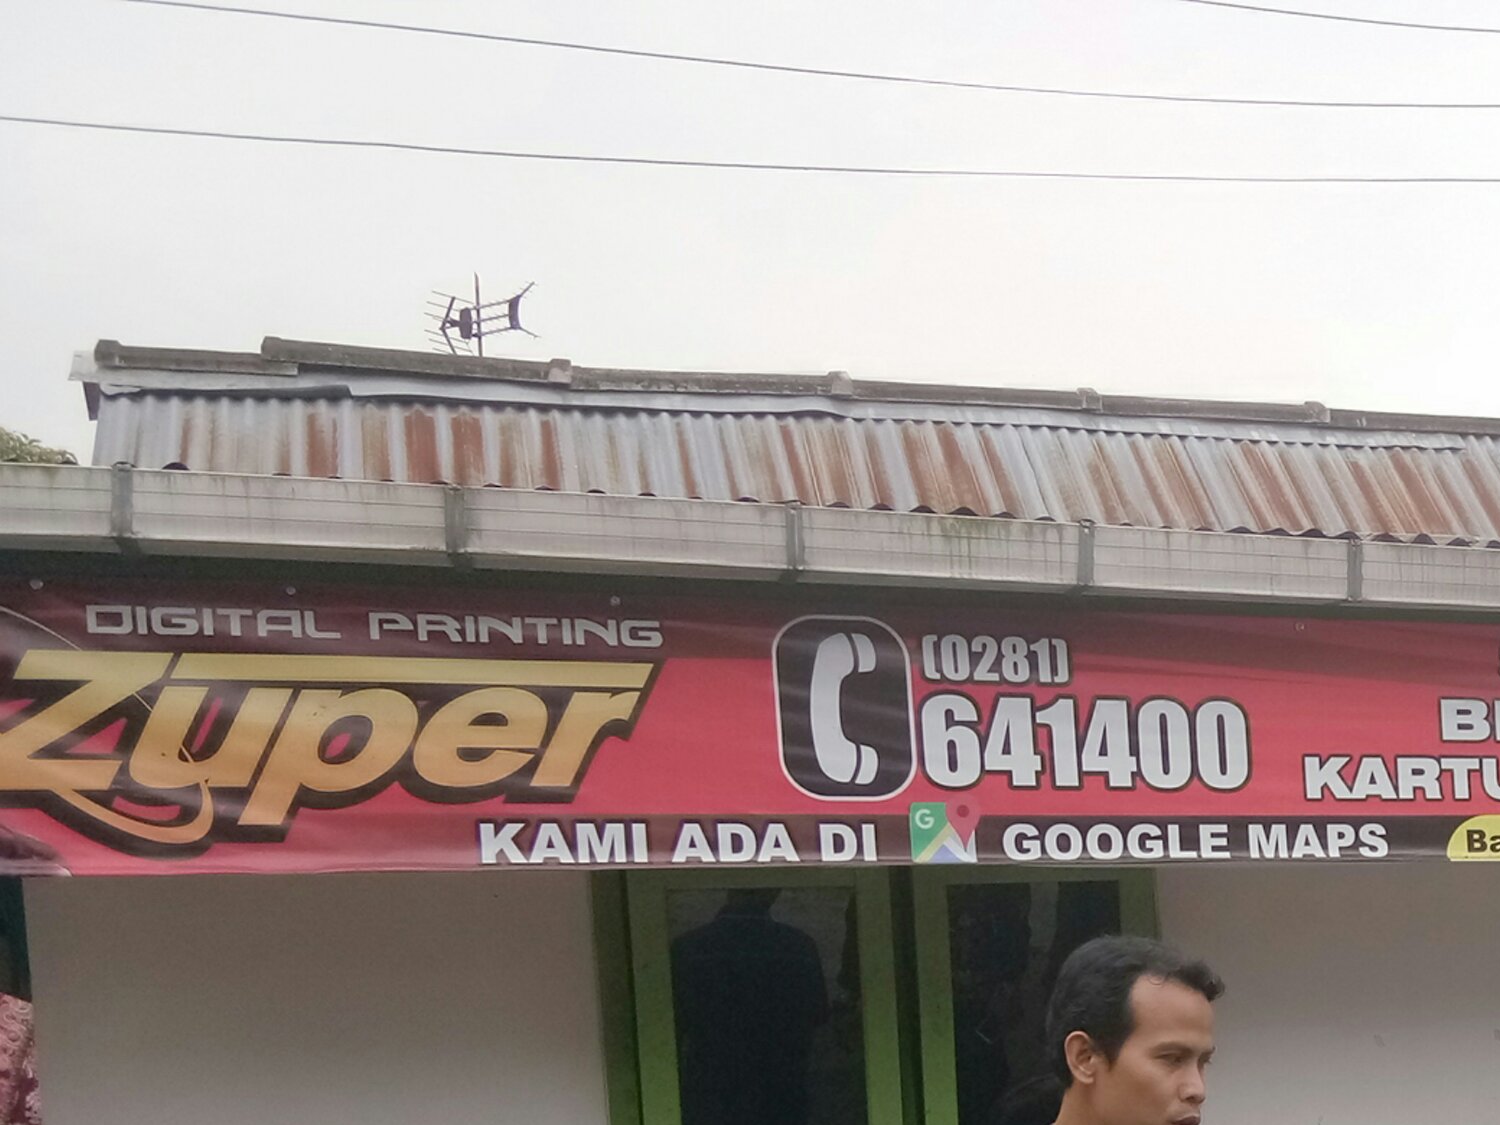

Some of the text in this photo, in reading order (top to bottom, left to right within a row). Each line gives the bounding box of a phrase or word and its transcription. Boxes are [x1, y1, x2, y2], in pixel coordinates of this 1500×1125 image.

[86, 604, 664, 648] DIGITAL PRINTING
[921, 634, 1070, 684] (0281)
[920, 694, 1251, 789] 641400
[479, 822, 878, 864] KAMI ADA DI
[1002, 822, 1389, 860] GOOGLE MAPS
